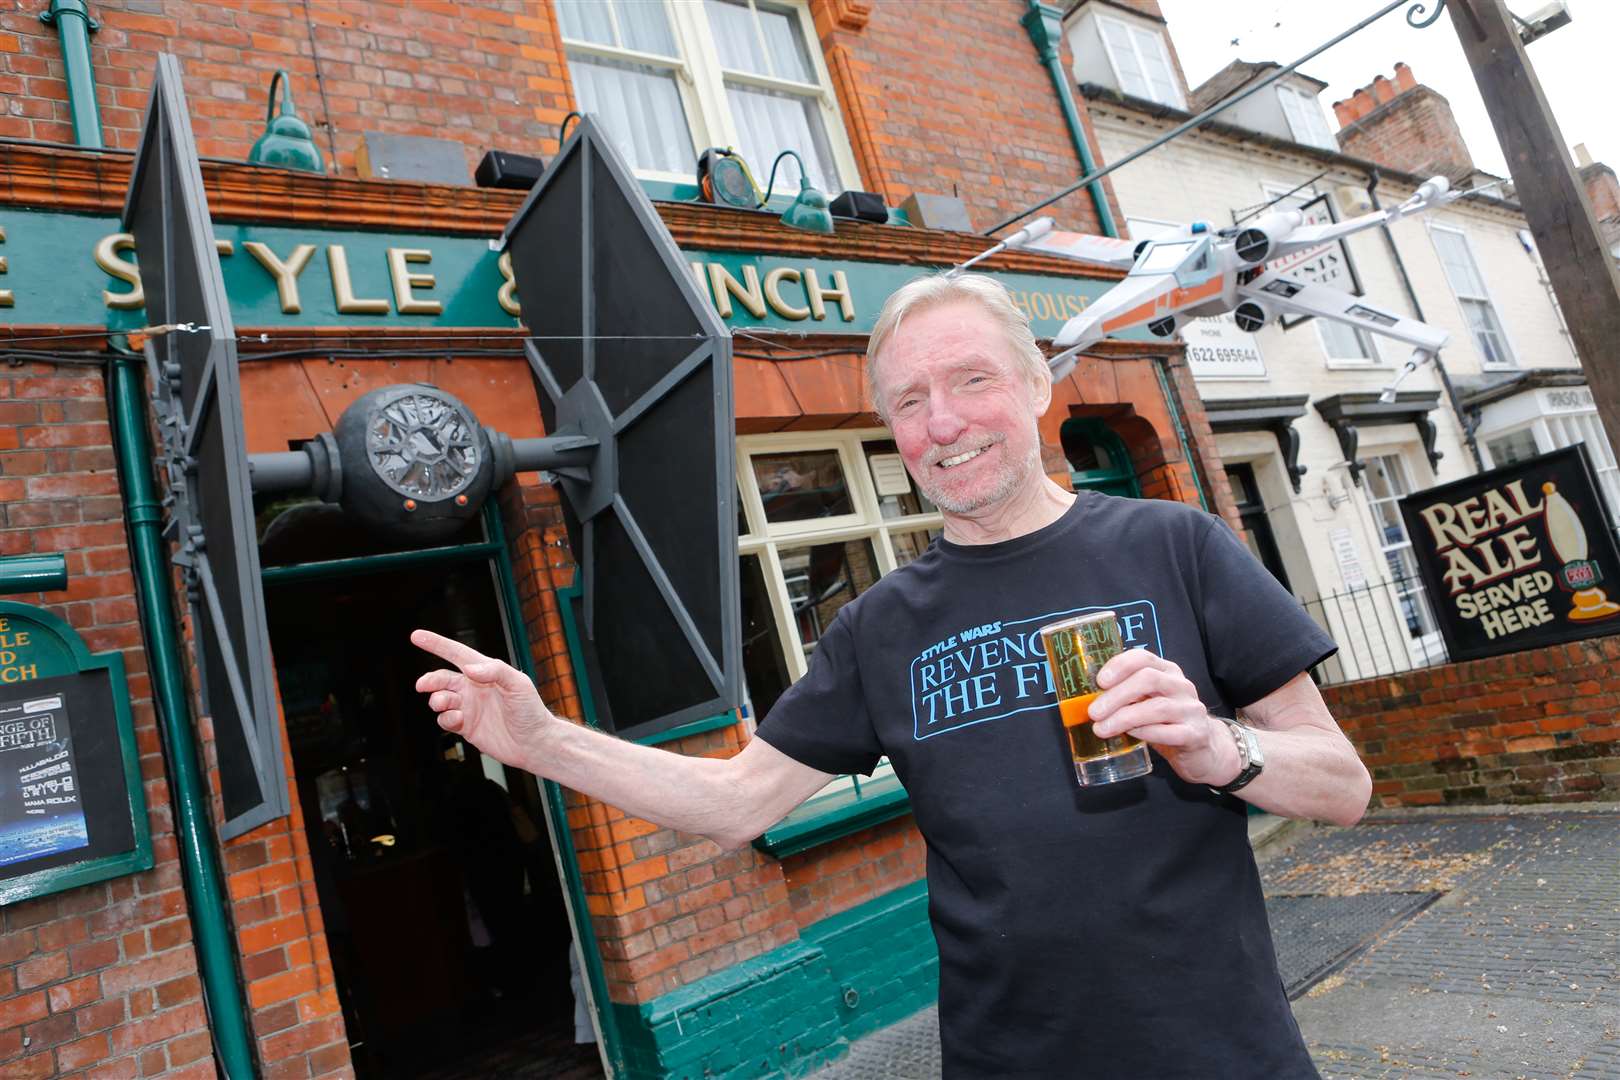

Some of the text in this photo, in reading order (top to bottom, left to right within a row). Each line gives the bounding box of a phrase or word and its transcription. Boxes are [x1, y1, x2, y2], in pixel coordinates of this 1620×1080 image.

[1419, 479, 1544, 550] REAL
[1441, 525, 1543, 593] ALE
[1456, 570, 1554, 619] SERVED
[920, 620, 1002, 661] STYLE WARS
[1479, 599, 1554, 640] HERE
[922, 672, 1001, 725] THE
[0, 727, 51, 748] FIFTH
